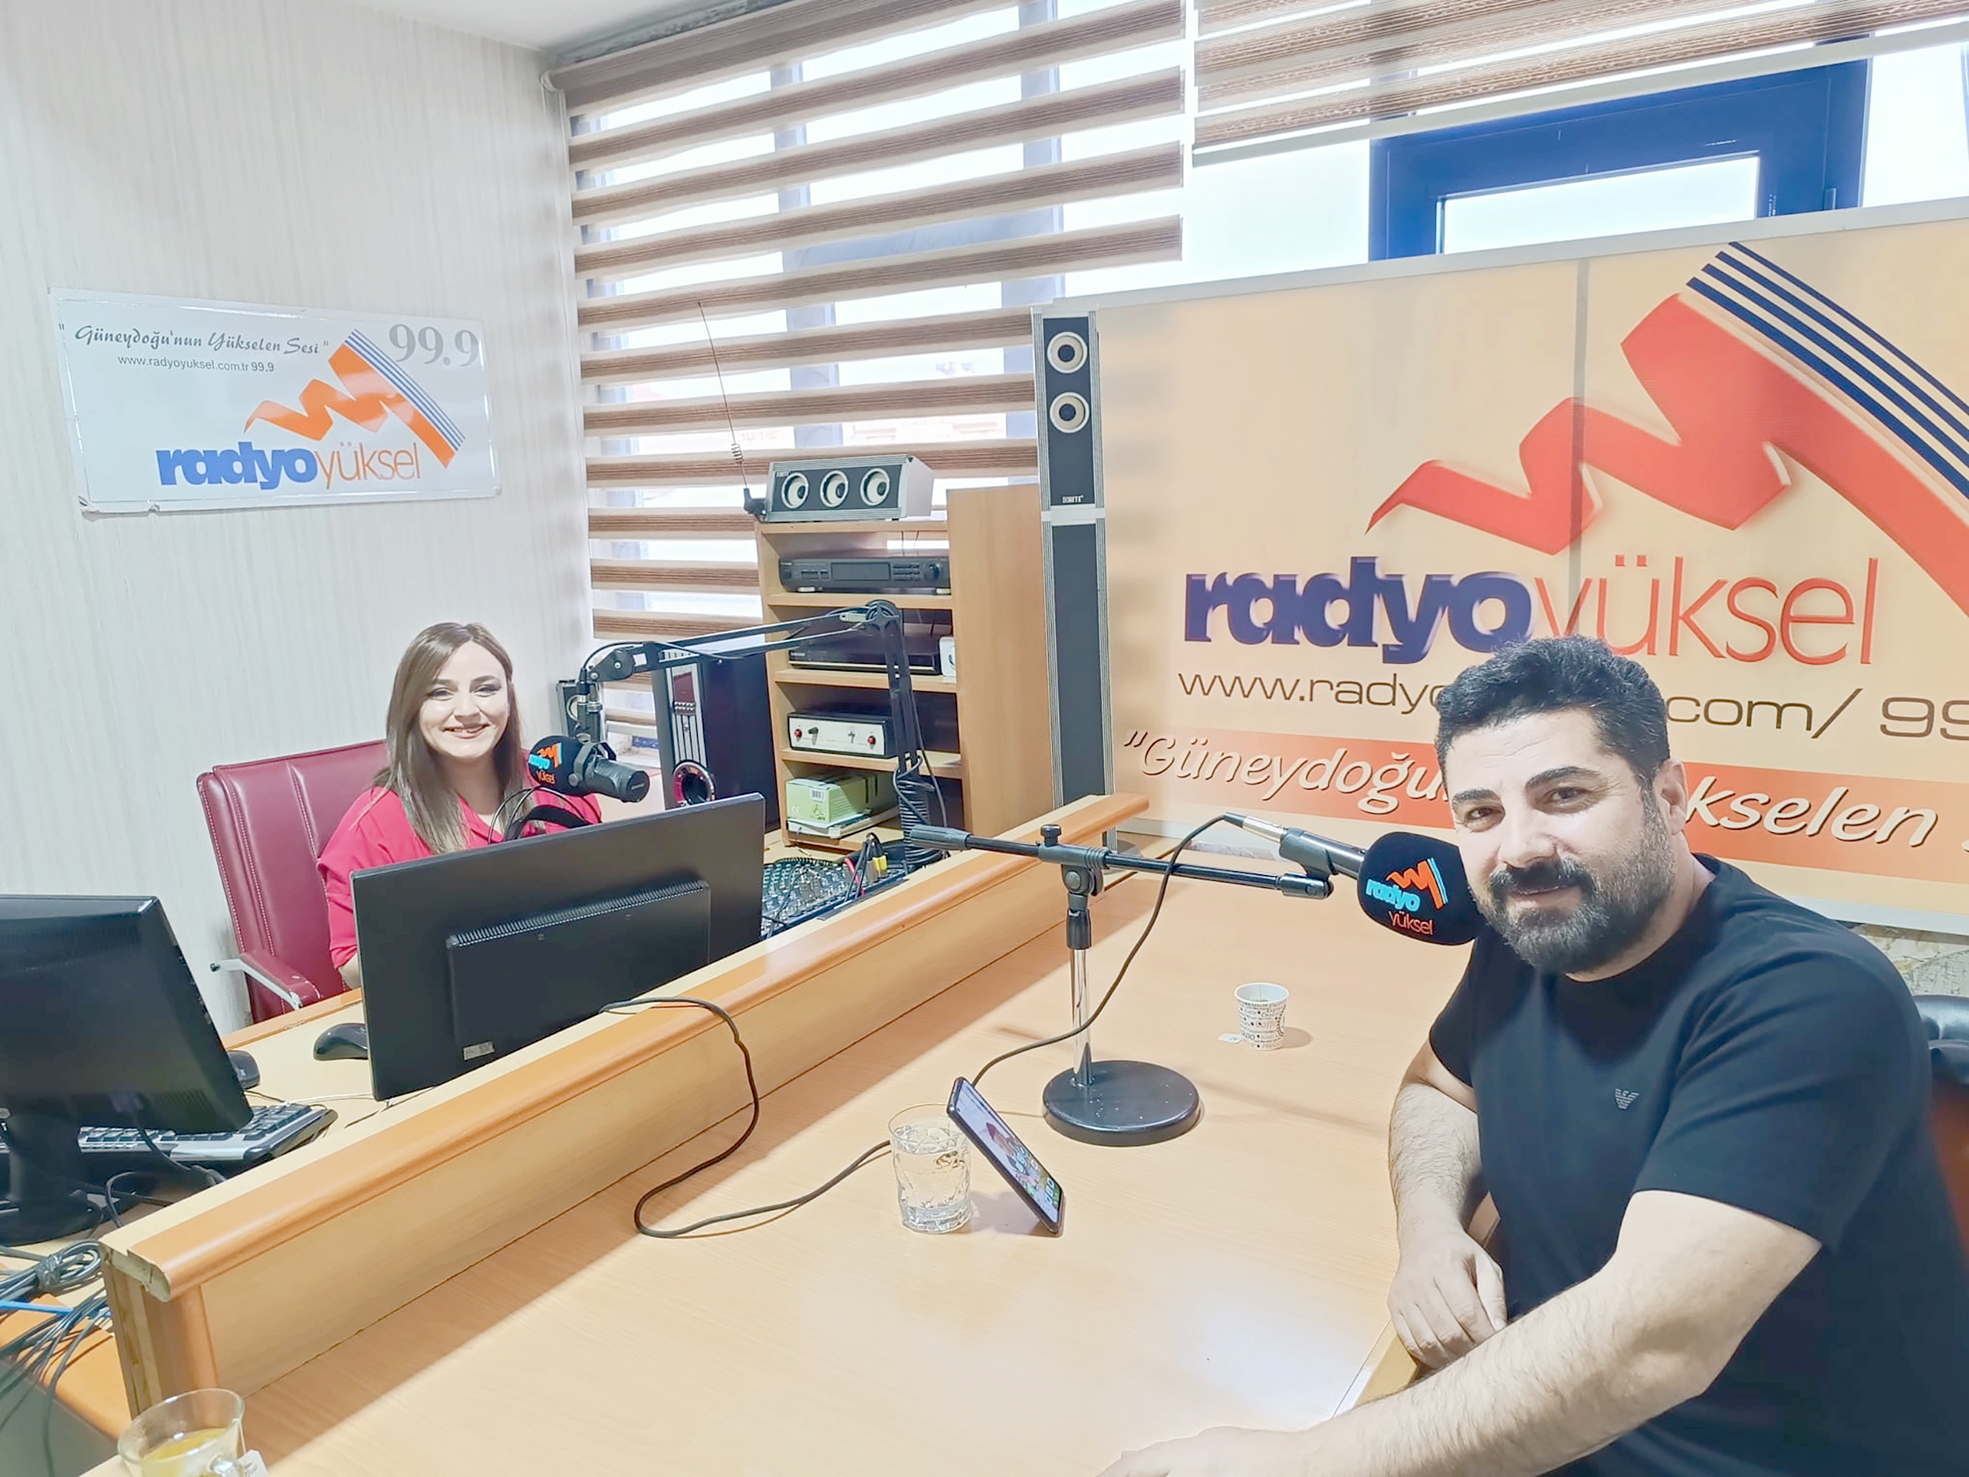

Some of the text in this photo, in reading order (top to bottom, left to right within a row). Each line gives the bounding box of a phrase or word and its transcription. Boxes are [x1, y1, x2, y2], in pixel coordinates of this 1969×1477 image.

[208, 331, 280, 351] Yükselen
[388, 323, 479, 367] 99.9
[117, 355, 249, 372] www.radyoyuksel.com.tr
[1365, 878, 1420, 912] radyo
[1388, 910, 1434, 935] yüksel
